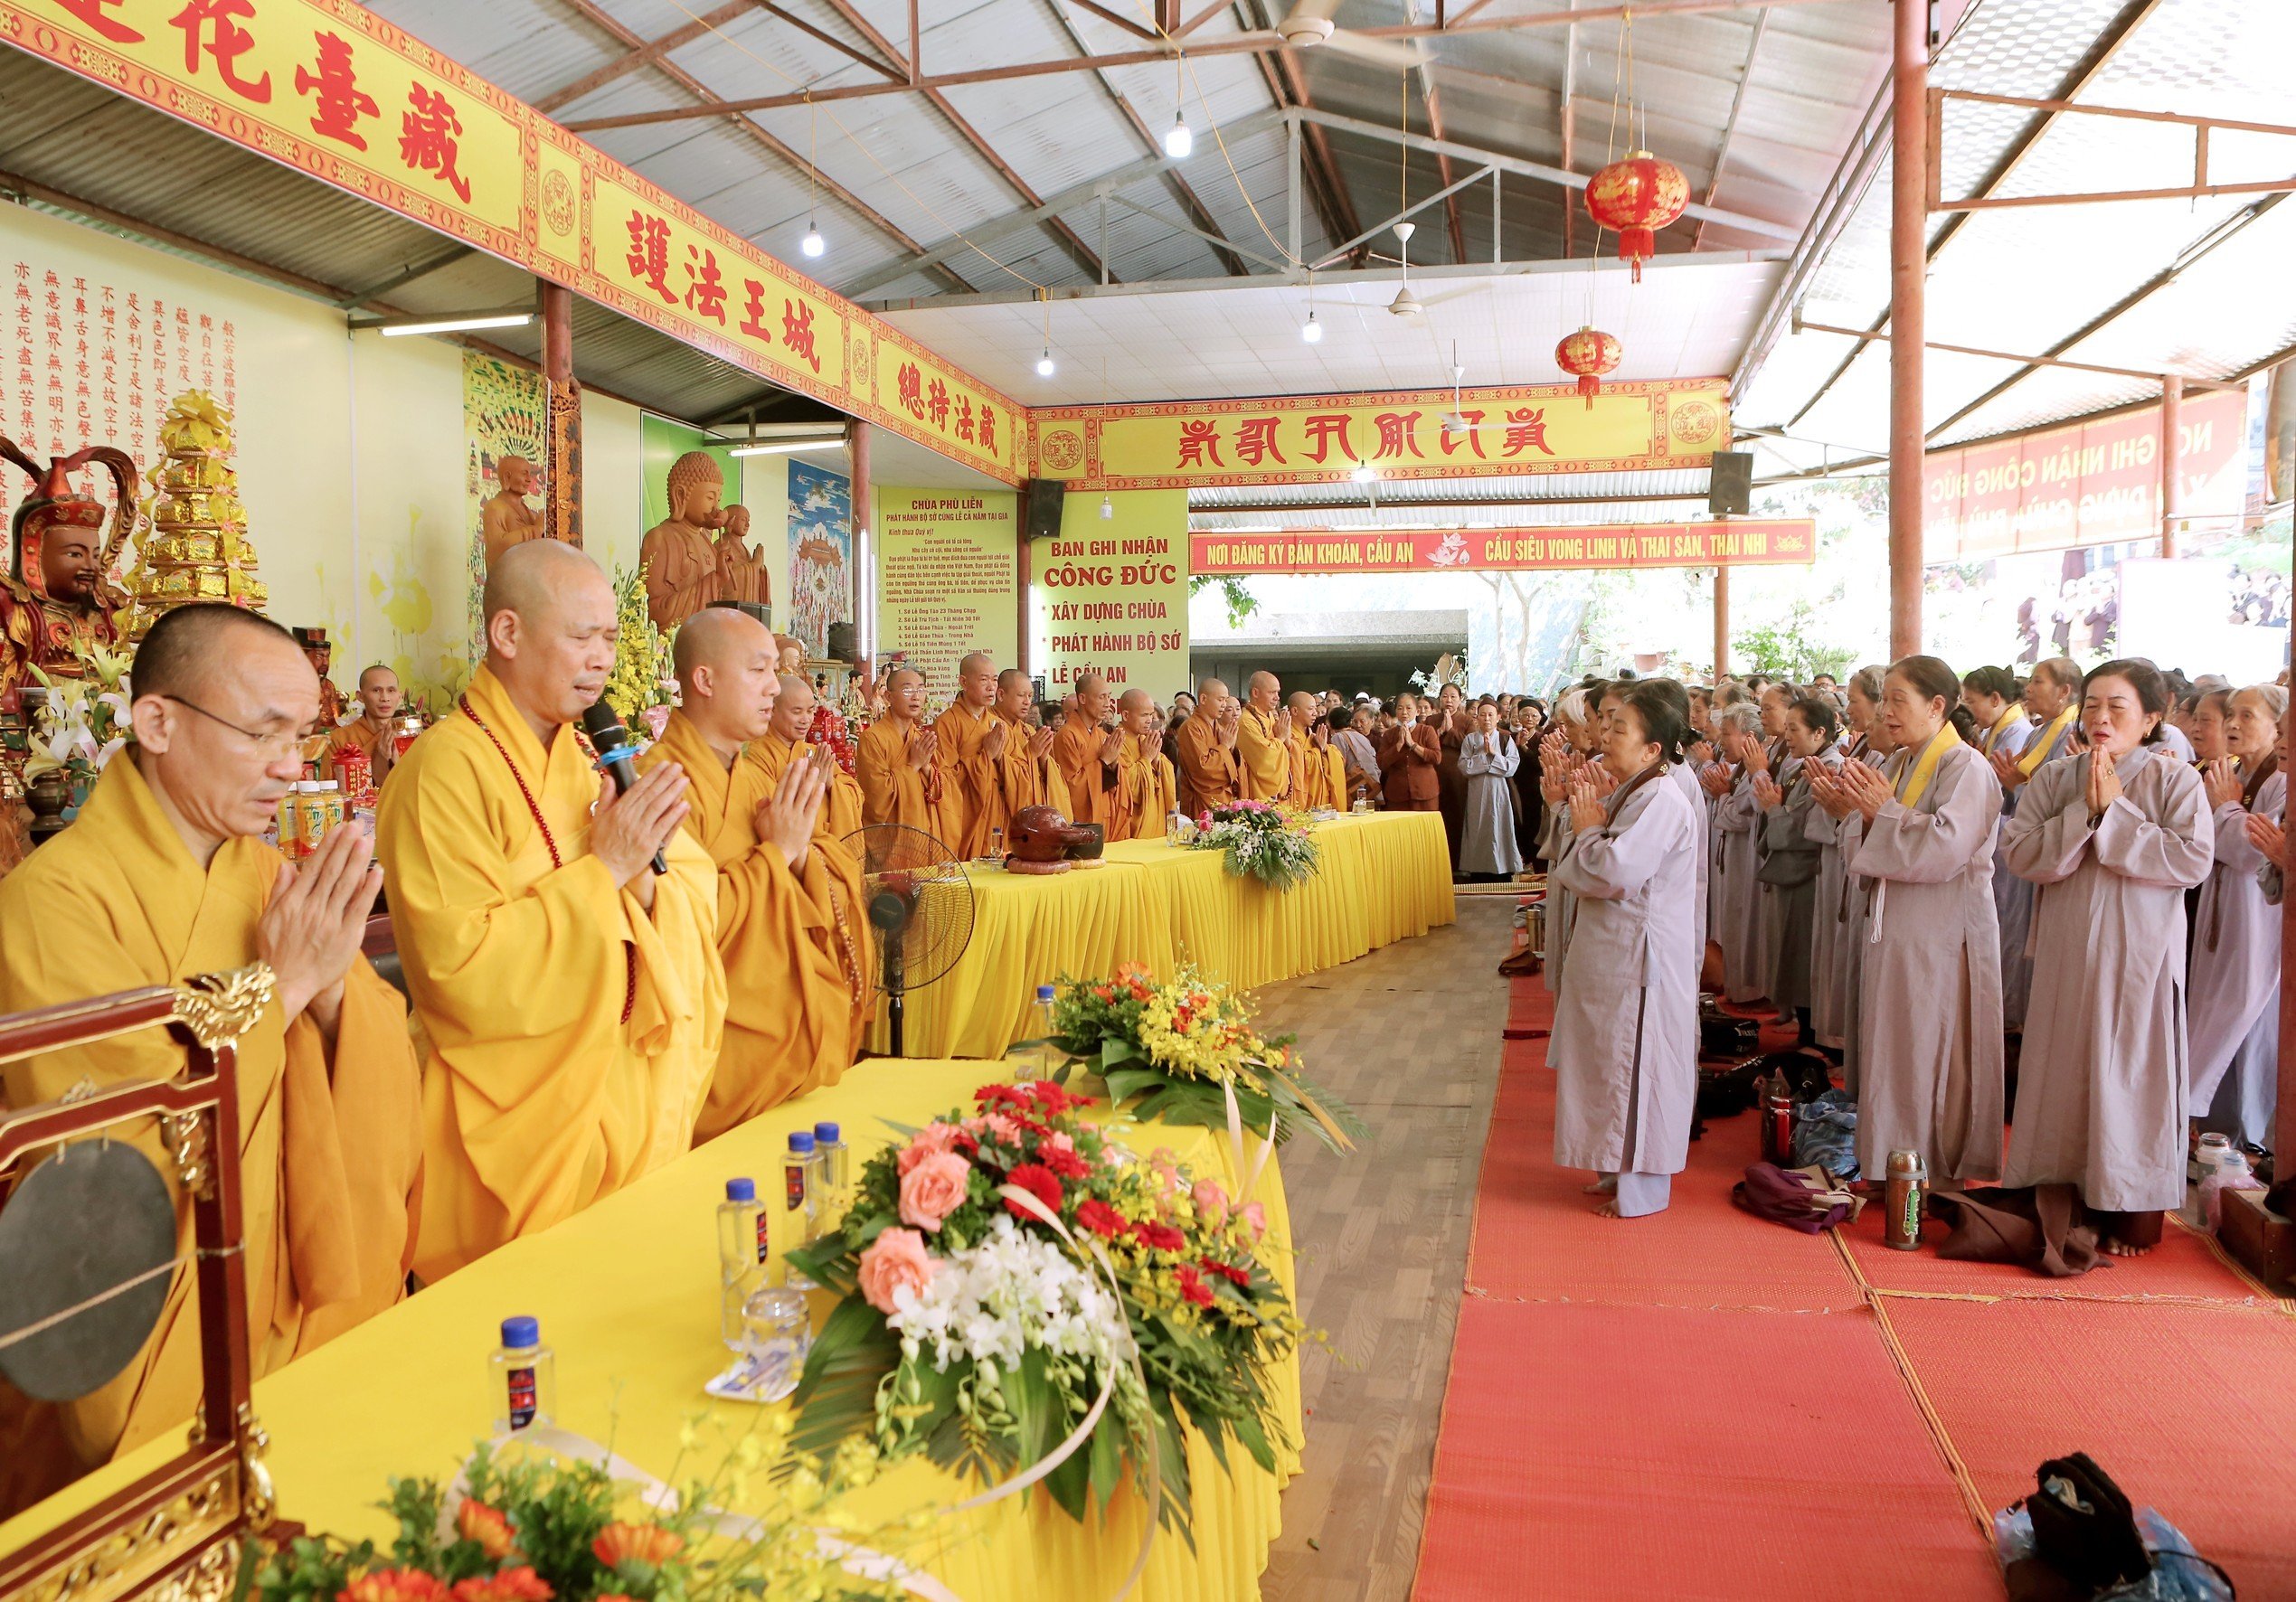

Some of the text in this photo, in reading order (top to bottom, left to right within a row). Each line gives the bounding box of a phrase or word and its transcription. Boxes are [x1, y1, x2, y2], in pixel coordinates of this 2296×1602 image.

[626, 210, 821, 374] 護法王城
[200, 314, 214, 392] 觀自在菩
[896, 362, 998, 458] 總持法藏
[912, 498, 937, 510] CHÙA
[940, 497, 959, 509] PHÙ
[1051, 535, 1168, 558] BAN GHI NHẬN
[1207, 534, 1414, 567] NƠI ĐĂNG KÝ BÁN KHOÁN, CẦU AN
[1485, 532, 1512, 561] CẦU
[1515, 535, 1545, 561] SIÊU
[1548, 536, 1583, 561] VONG
[1587, 534, 1617, 560] LINH
[1620, 528, 1638, 560] VÀ
[1640, 534, 1671, 559] THAI
[1709, 533, 1740, 557] THAI
[1743, 532, 1768, 556] NHI
[1044, 559, 1176, 588] CÔNG ĐỨC
[1052, 598, 1167, 624] XÂY DỰNG CHÙA
[1052, 629, 1182, 655] PHÁT HÀNH BỘ SỚ
[1052, 661, 1069, 683] LỄ
[1106, 666, 1127, 683] AN
